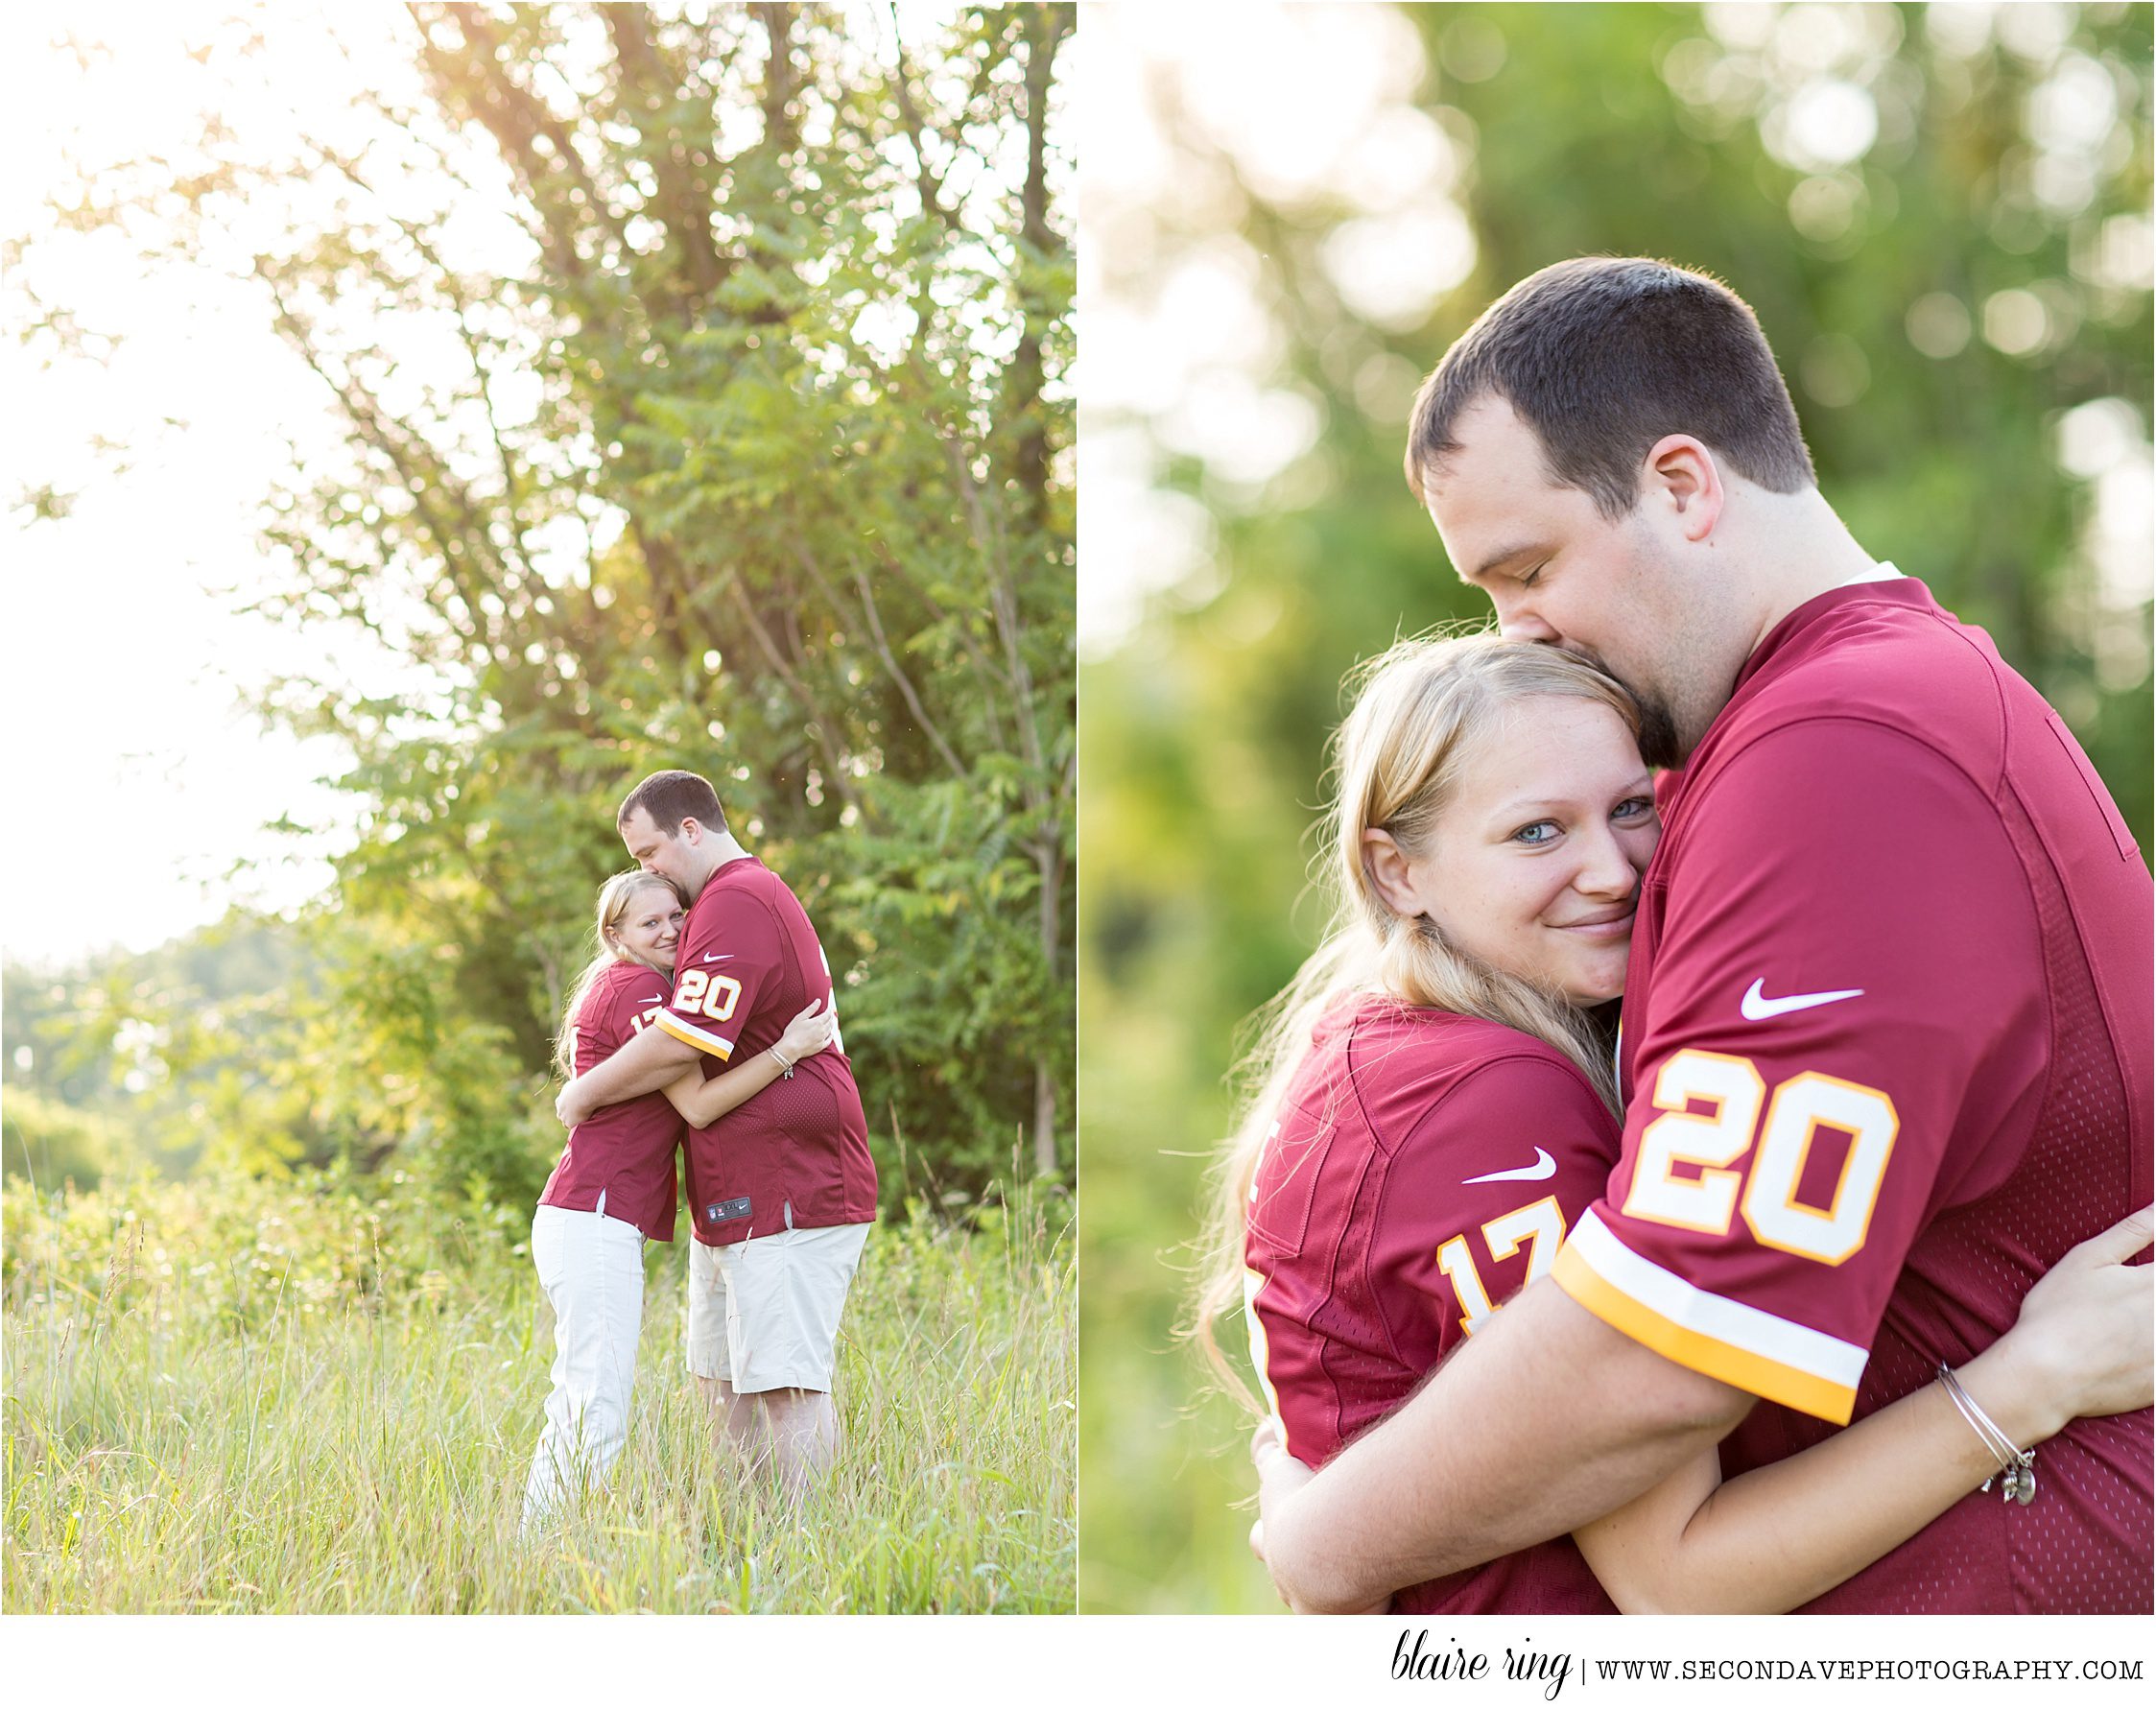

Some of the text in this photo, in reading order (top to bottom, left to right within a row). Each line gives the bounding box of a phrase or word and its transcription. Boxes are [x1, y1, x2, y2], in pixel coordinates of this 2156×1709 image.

[673, 969, 743, 1023] 20
[1622, 1048, 1901, 1268] 20
[1436, 1195, 1567, 1338] 17
